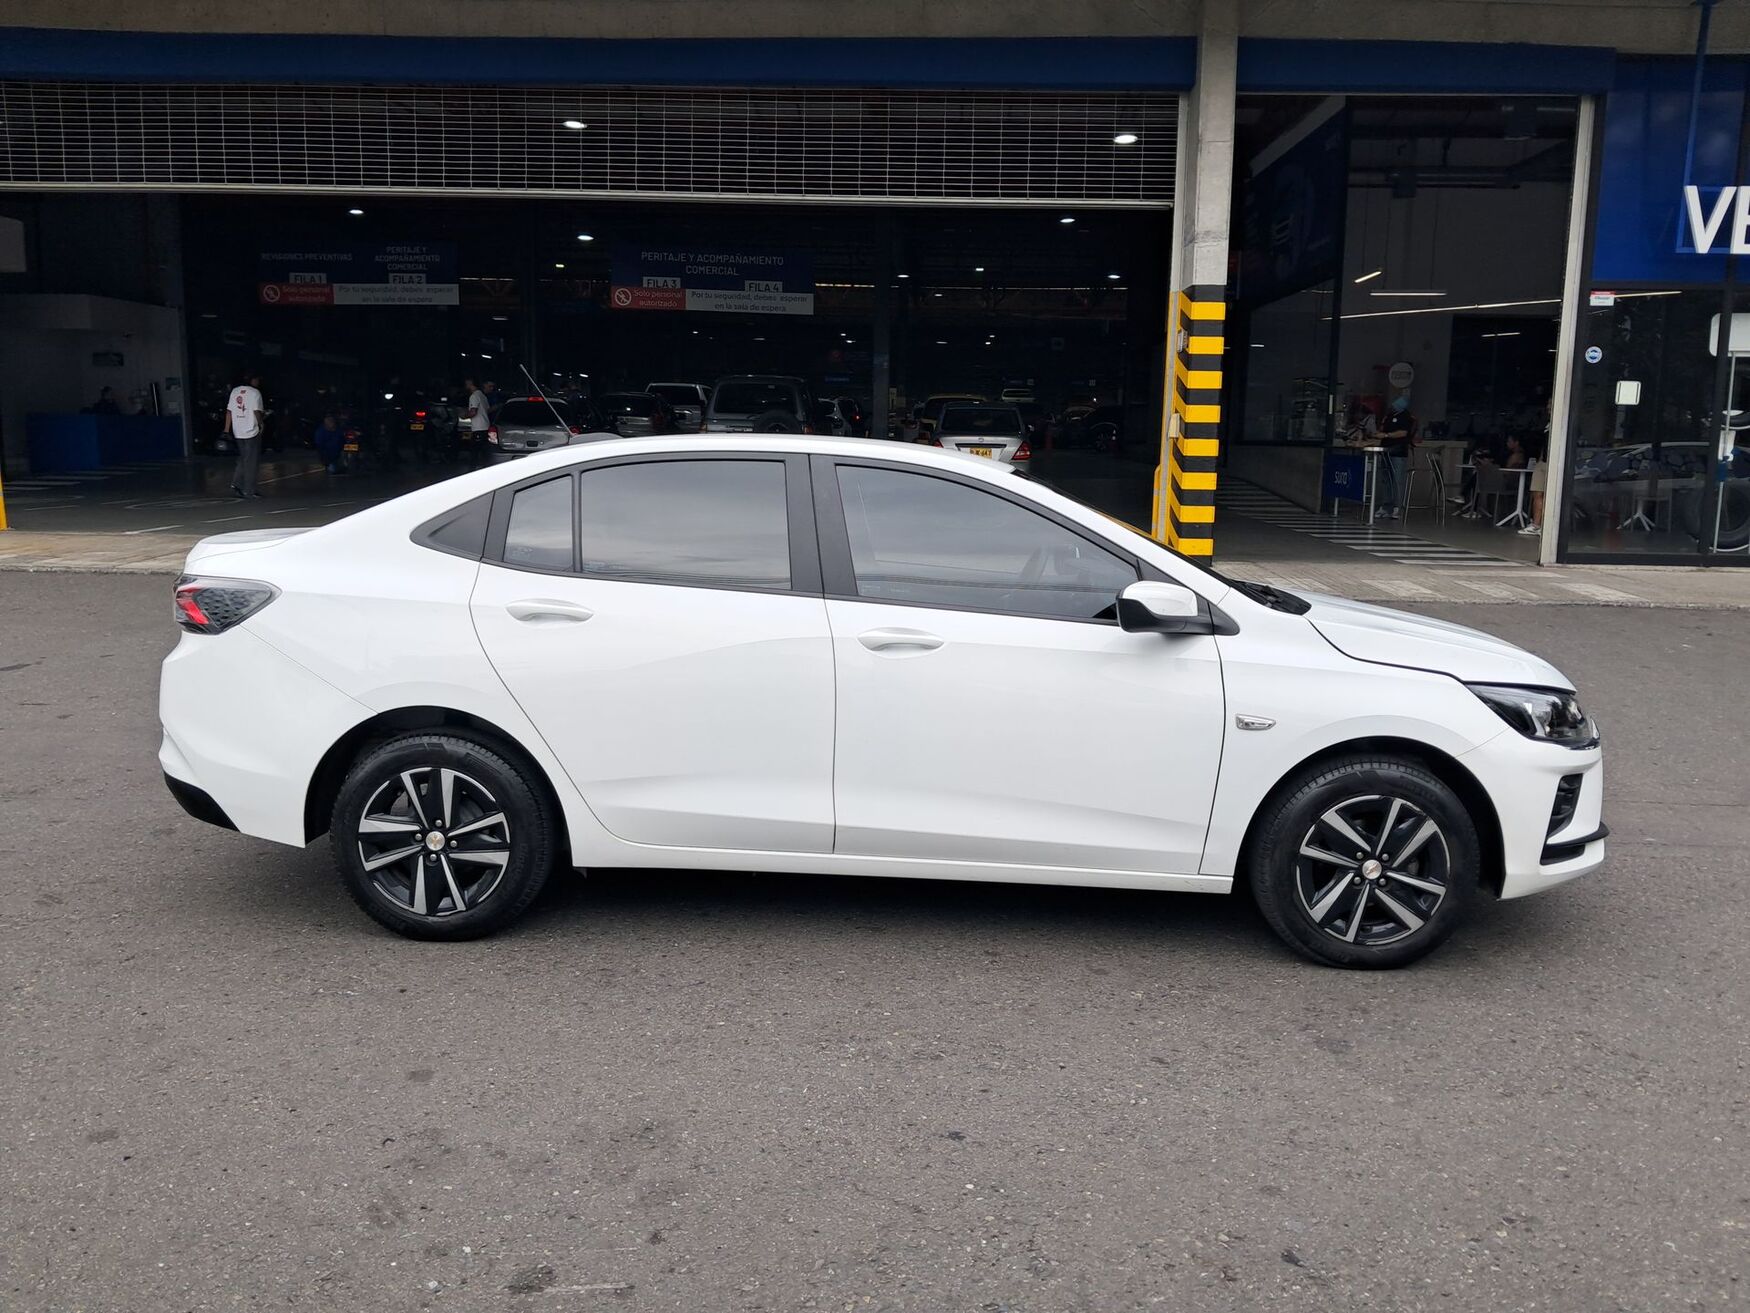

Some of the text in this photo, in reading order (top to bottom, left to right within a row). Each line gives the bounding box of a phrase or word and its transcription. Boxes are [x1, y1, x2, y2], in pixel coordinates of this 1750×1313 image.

[640, 251, 784, 266] PERITAJE Y ACOMPAÑAMIENTO
[387, 262, 428, 271] COMERCIAL
[686, 265, 740, 276] COMERCIAL
[294, 275, 315, 284] FILA
[392, 275, 424, 284] FILA 2
[647, 279, 678, 289] FILA 3
[748, 282, 779, 292] FILA 4
[650, 291, 683, 300] personal
[780, 295, 807, 304] esperar
[639, 299, 678, 308] autorizado
[734, 303, 748, 311] sala
[761, 305, 786, 313] espera
